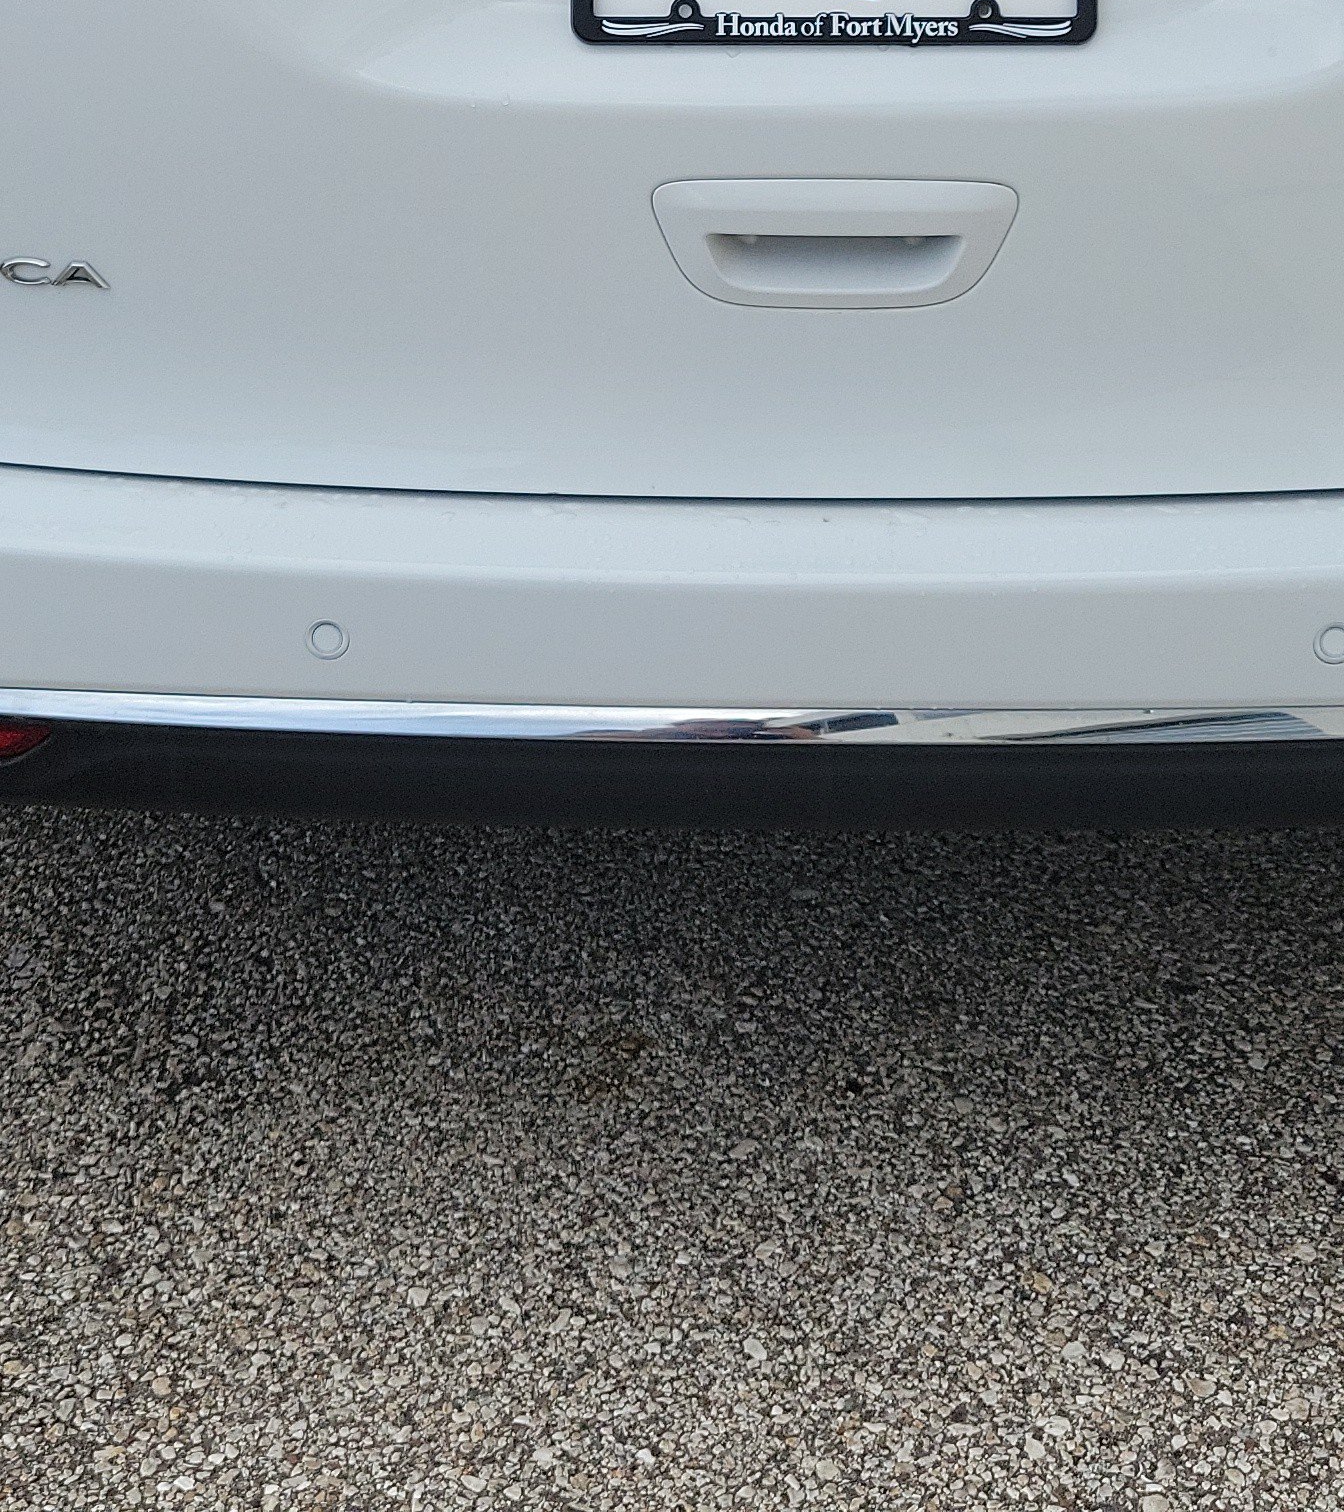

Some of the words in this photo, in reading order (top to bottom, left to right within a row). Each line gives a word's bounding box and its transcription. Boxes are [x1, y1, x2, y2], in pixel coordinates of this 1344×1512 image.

[715, 13, 799, 36] Honda
[800, 13, 827, 36] of
[830, 13, 883, 36] Fort
[884, 13, 959, 44] Myers
